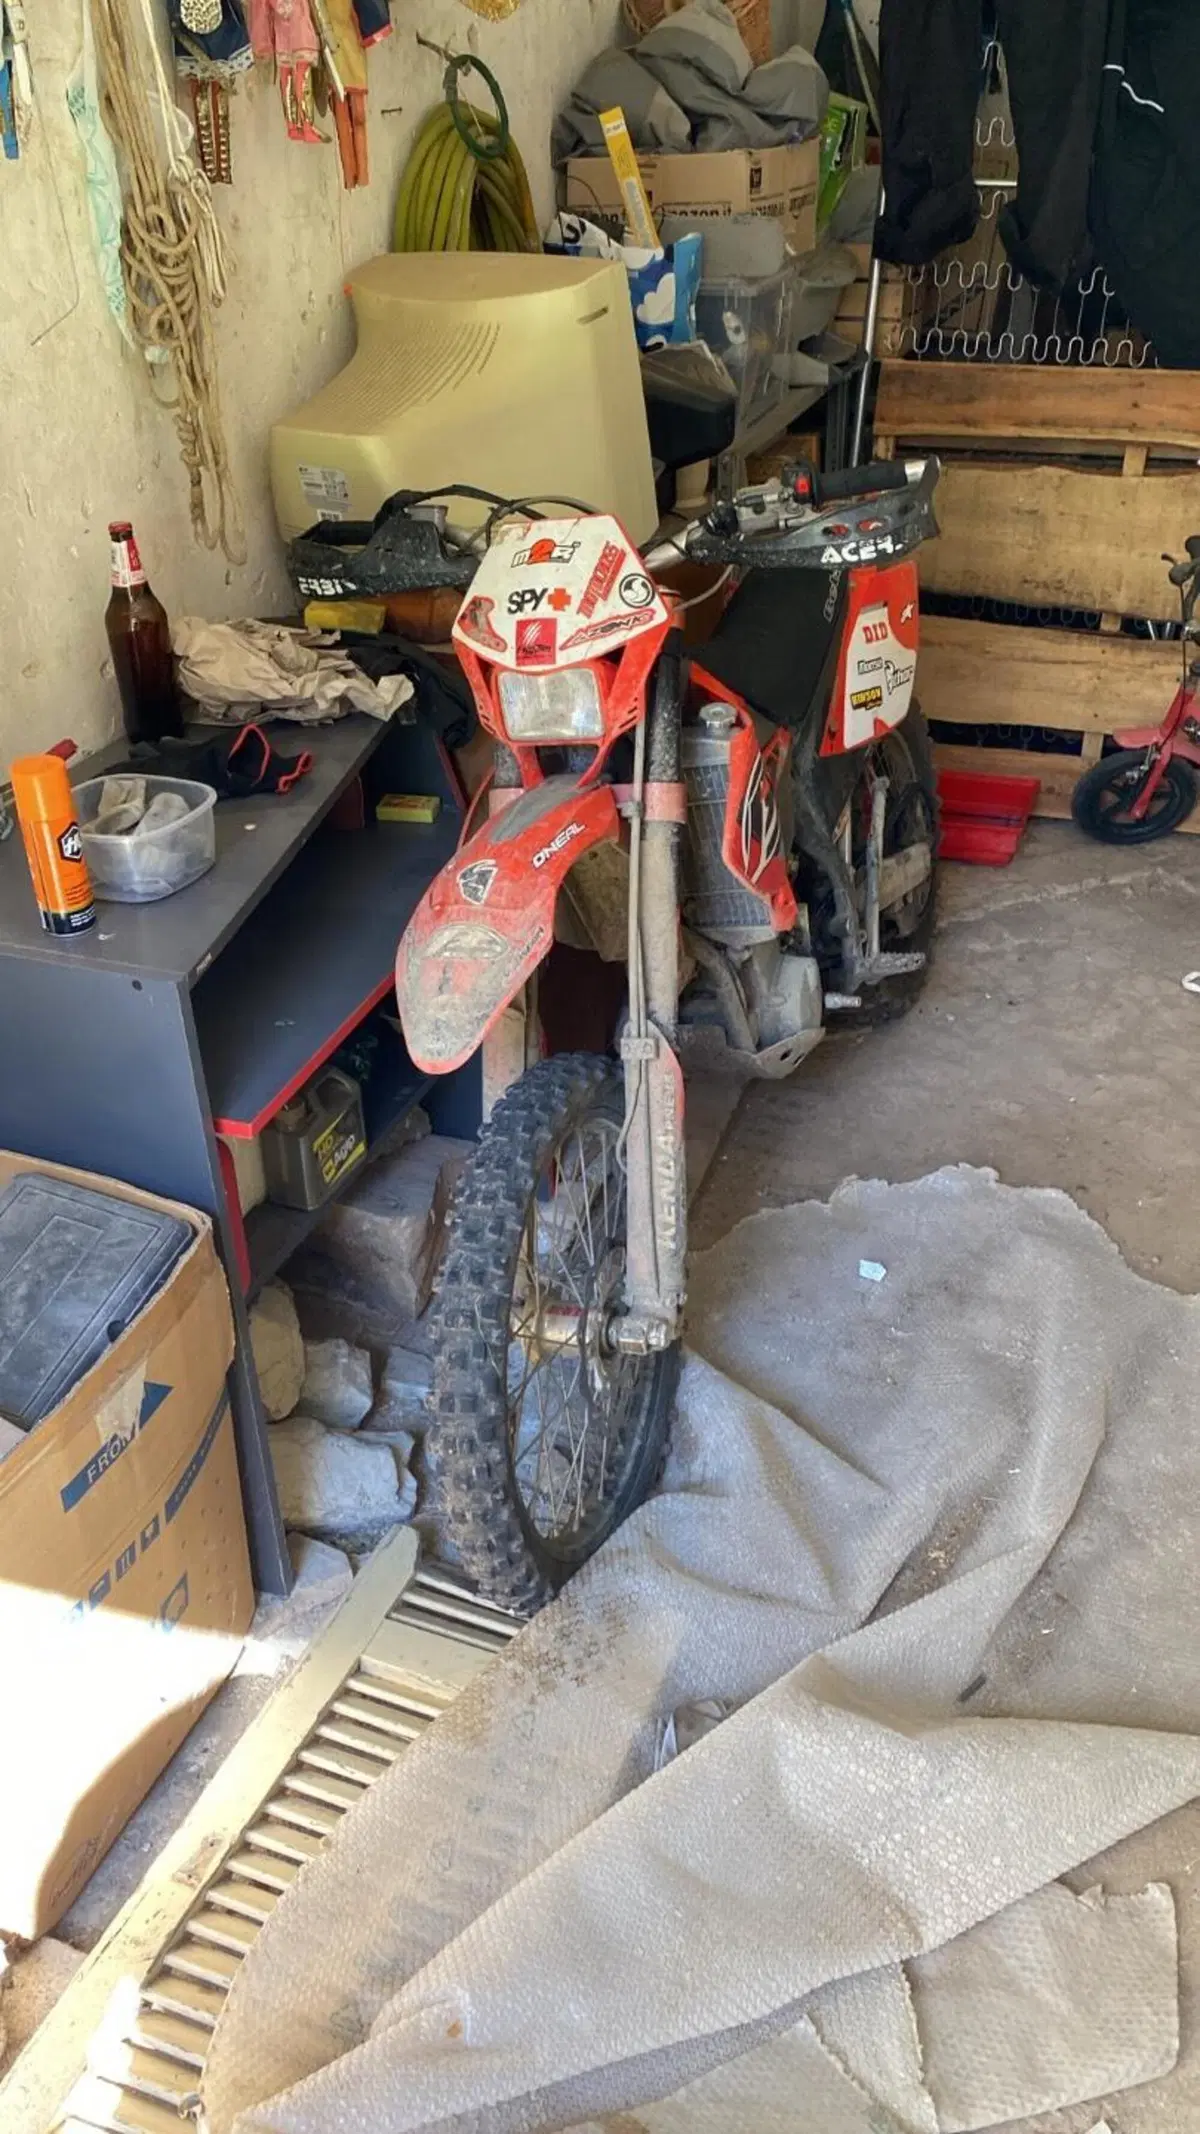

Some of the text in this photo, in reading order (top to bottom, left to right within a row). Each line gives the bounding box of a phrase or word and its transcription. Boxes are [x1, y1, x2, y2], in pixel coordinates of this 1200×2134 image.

[507, 588, 548, 614] SPY
[532, 821, 586, 869] ONEAL
[655, 1134, 677, 1249] KENDA
